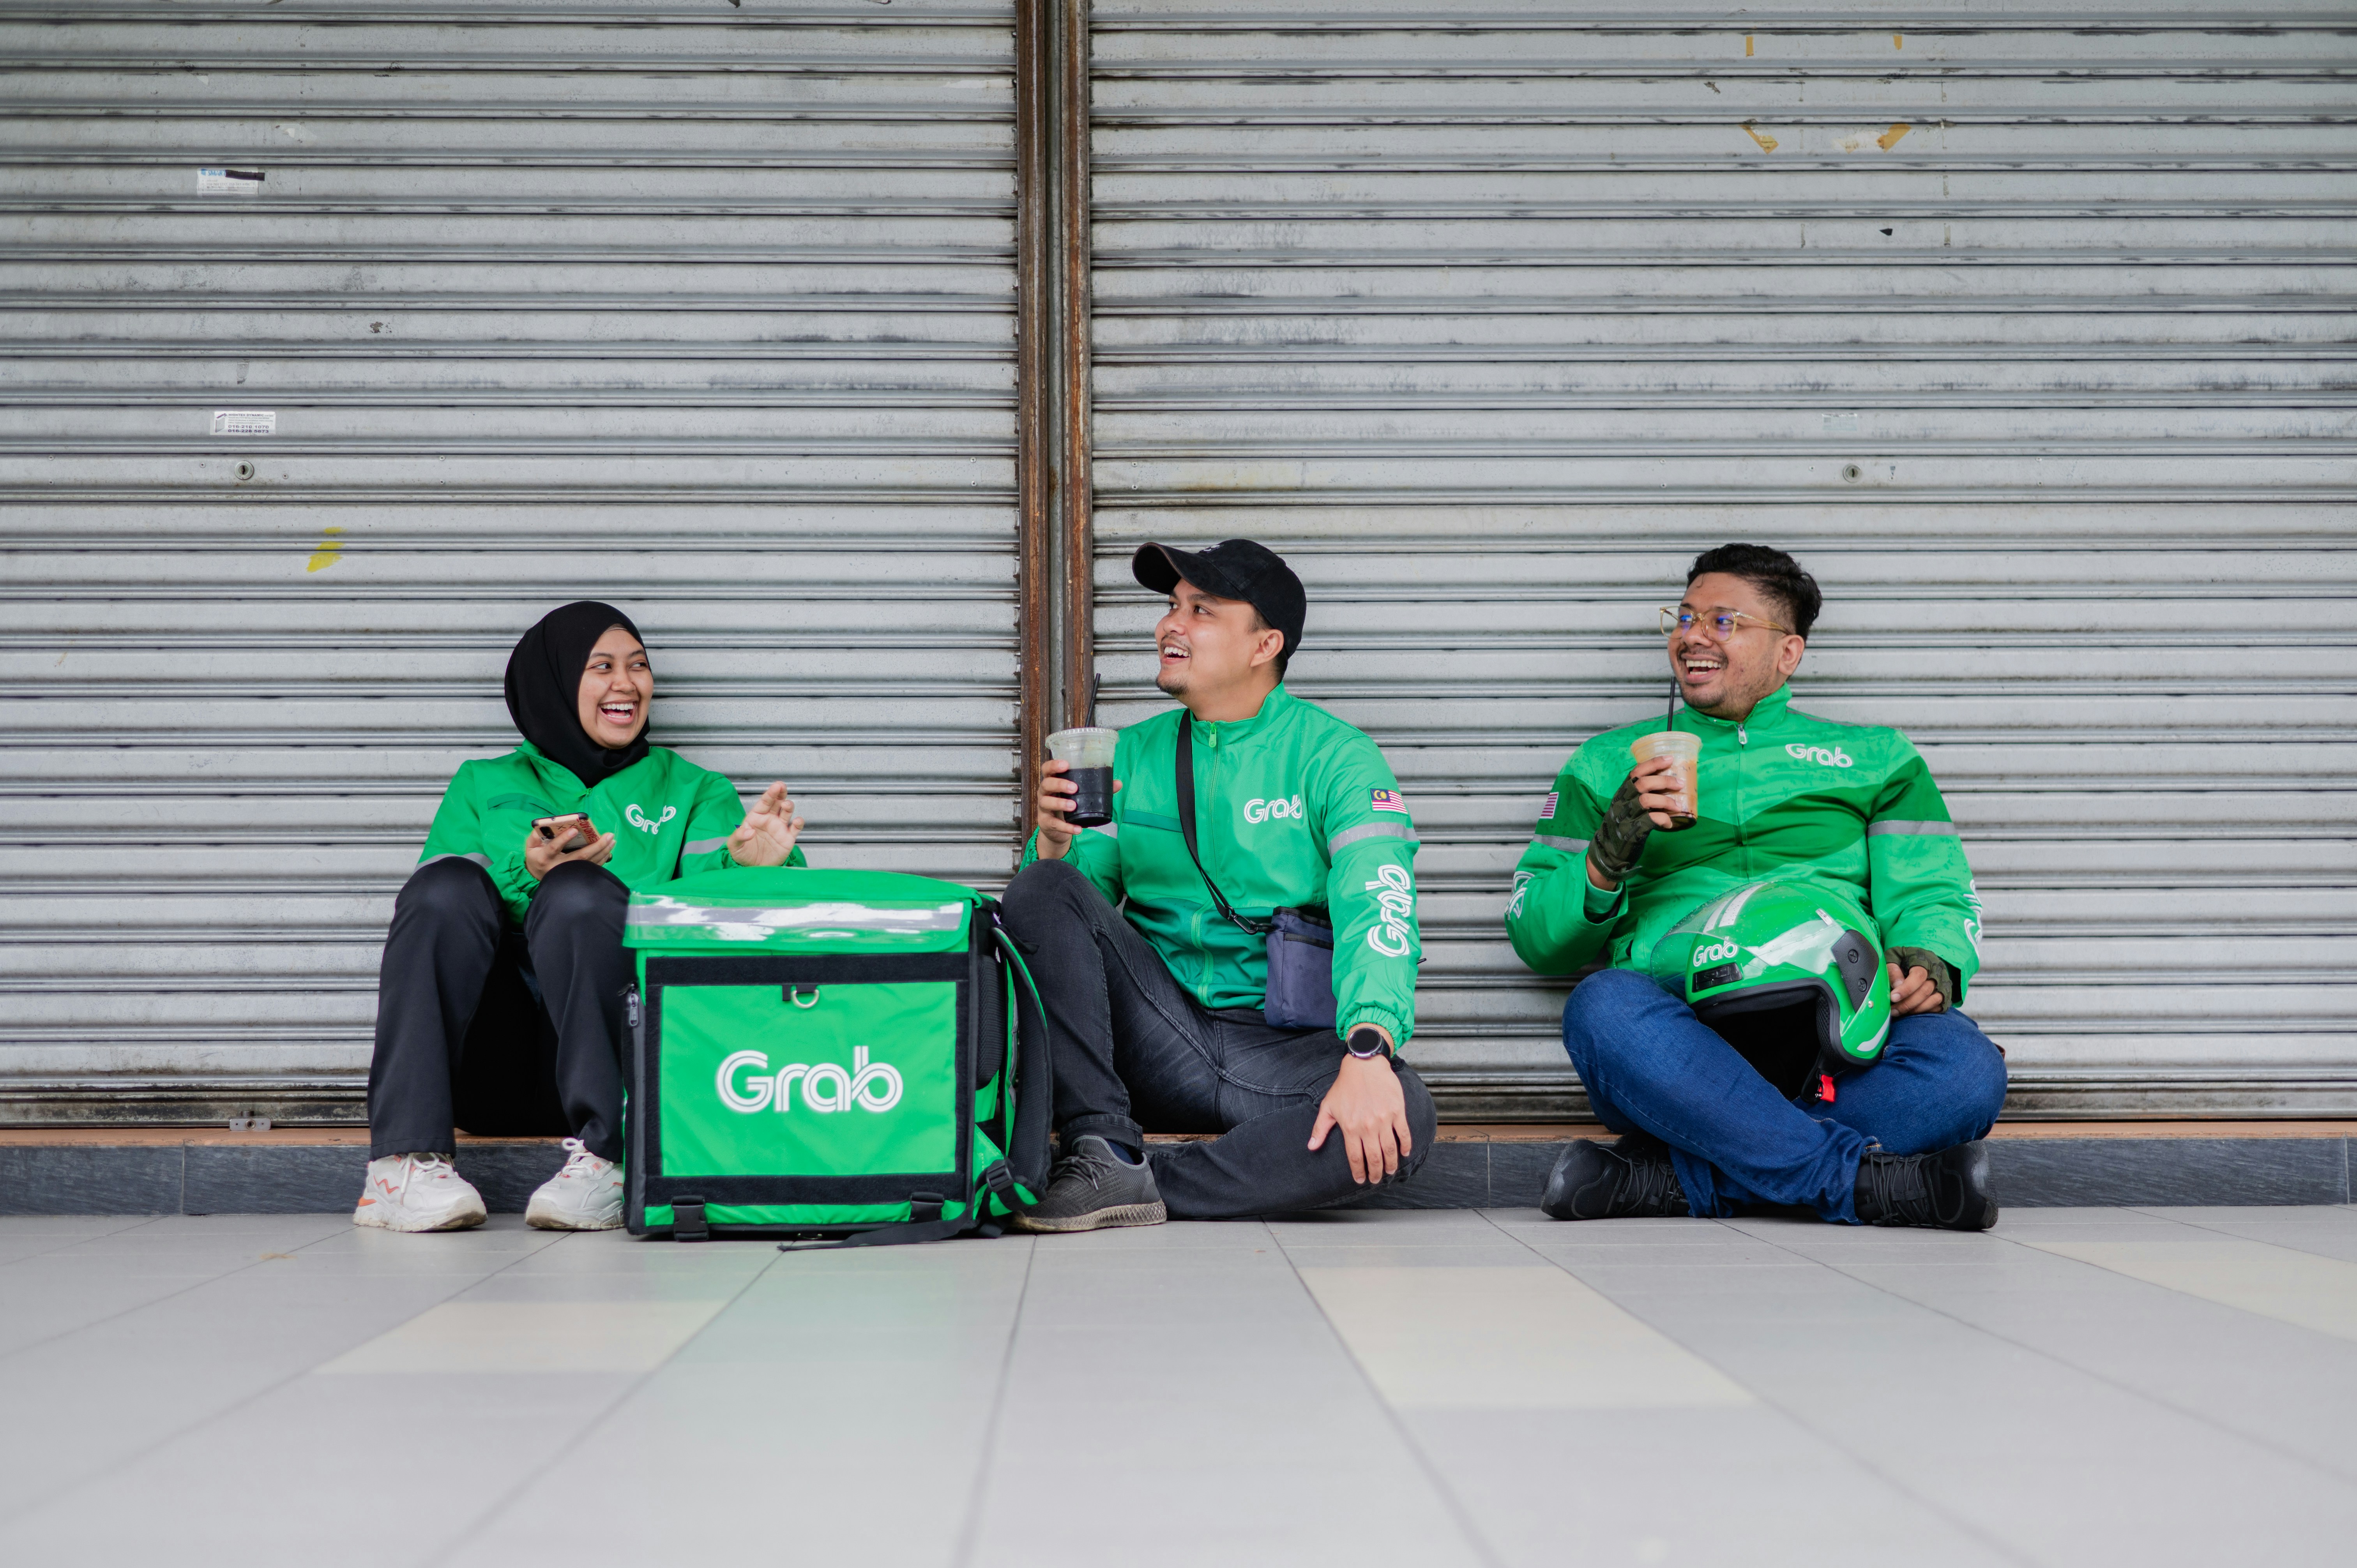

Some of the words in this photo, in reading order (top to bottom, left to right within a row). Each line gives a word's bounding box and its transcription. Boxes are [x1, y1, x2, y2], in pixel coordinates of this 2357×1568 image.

[1785, 743, 1853, 768] Grab
[1244, 795, 1303, 824] Grab
[1365, 864, 1413, 957] Grab
[1693, 936, 1738, 967] Grab
[716, 1045, 904, 1113] Grab
